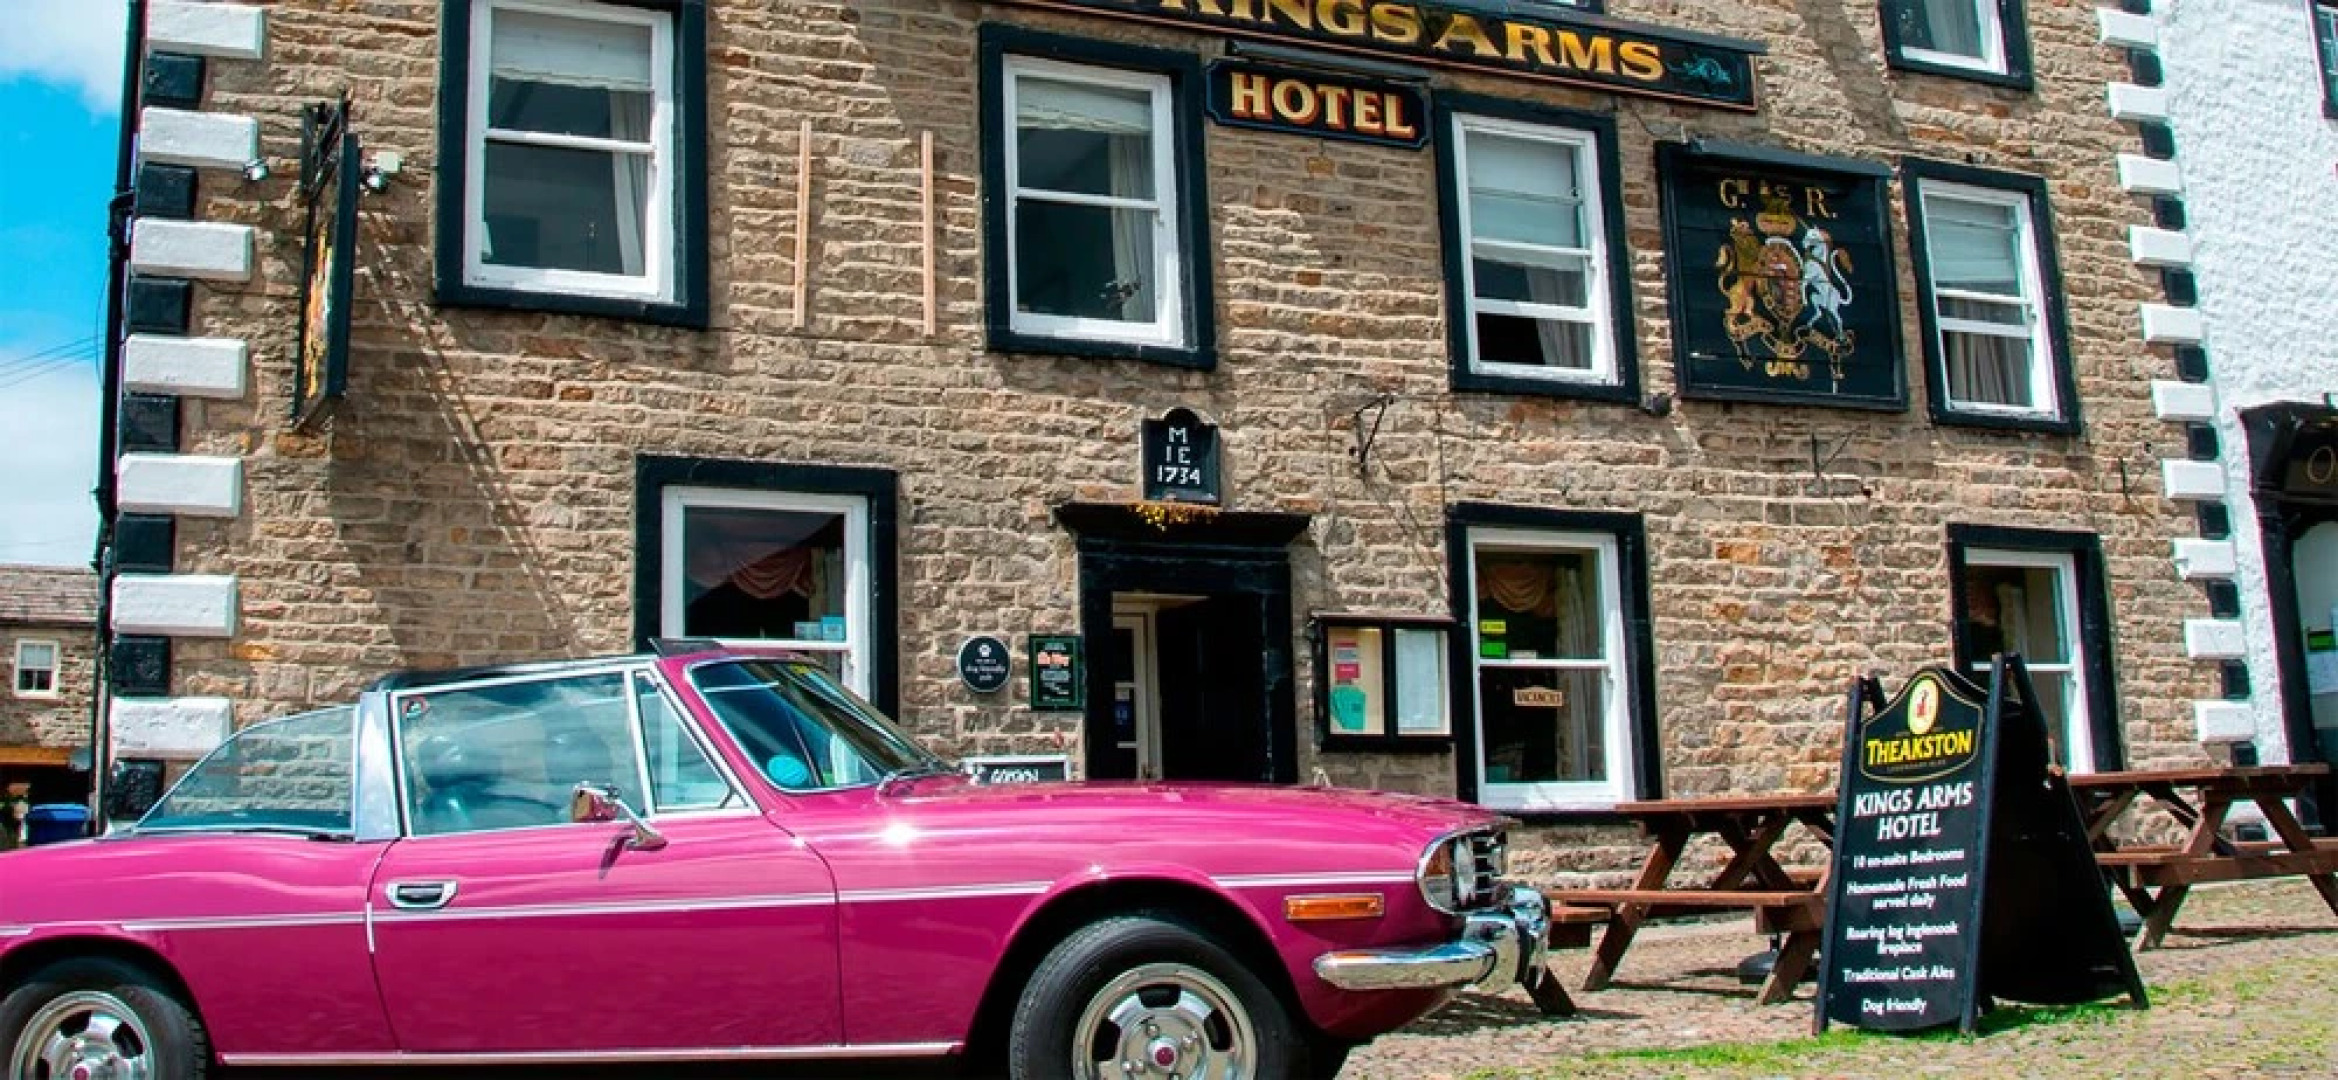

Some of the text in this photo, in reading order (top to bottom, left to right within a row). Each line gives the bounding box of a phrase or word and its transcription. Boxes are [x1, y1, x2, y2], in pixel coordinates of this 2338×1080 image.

[1432, 14, 1665, 81] ARMS
[1231, 72, 1415, 138] HOTEL
[1168, 426, 1188, 444] M
[1157, 465, 1200, 485] 1734
[1867, 729, 1973, 766] THEAKSTON
[1854, 781, 1973, 818] KINGS ARMS
[1877, 811, 1942, 841] HOTEL
[1910, 848, 1965, 864] Bedrooms
[1847, 872, 1968, 895] Homemade Fresh Food
[1873, 892, 1937, 909] served daily
[1846, 925, 1885, 943] Roaring
[1887, 924, 1904, 941] log
[1877, 940, 1923, 957] fireplace
[1842, 965, 1956, 982] Traditional Cask Ales
[1862, 997, 1928, 1015] Dog friendly
